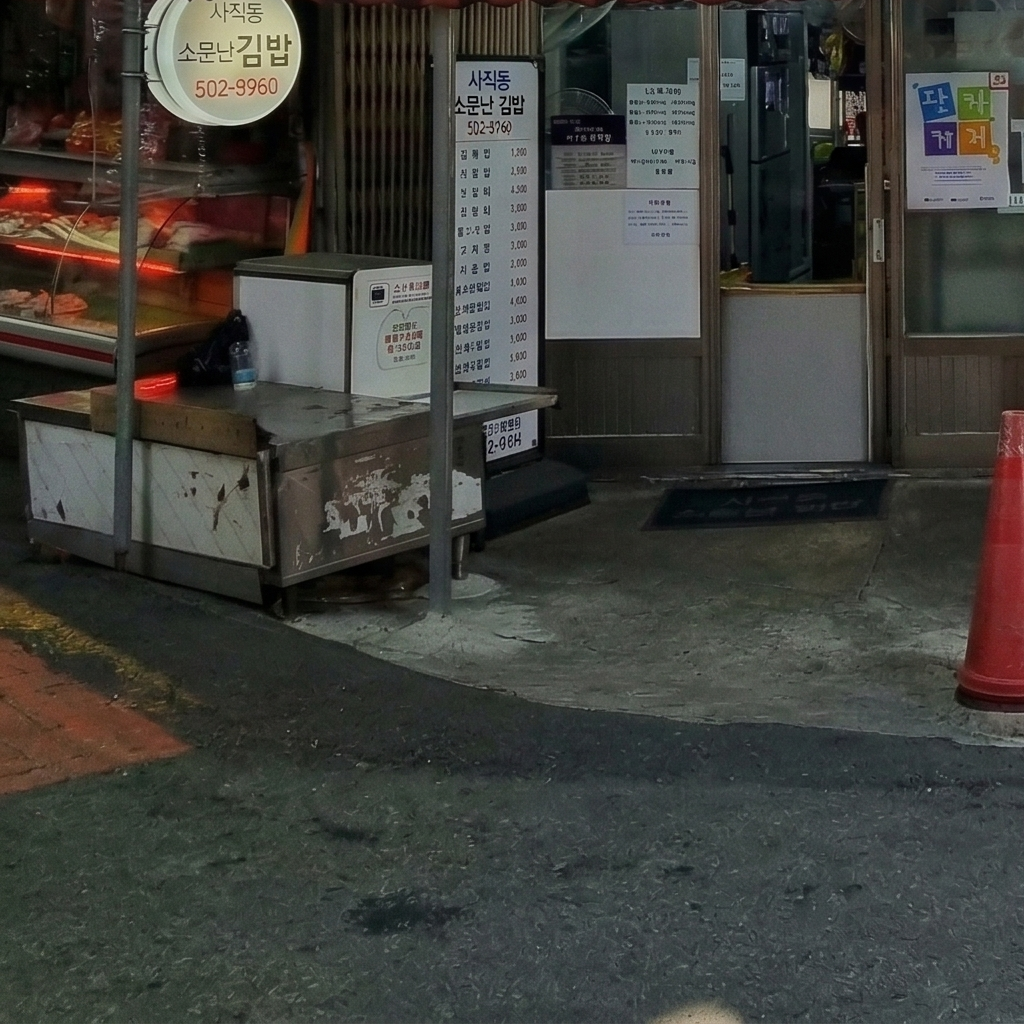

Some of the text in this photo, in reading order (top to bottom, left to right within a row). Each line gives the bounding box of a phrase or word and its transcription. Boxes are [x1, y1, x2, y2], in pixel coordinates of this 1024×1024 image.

[209, 2, 264, 24] 사직동
[468, 70, 511, 92] 사직동
[455, 95, 525, 116] 소문난 김밥
